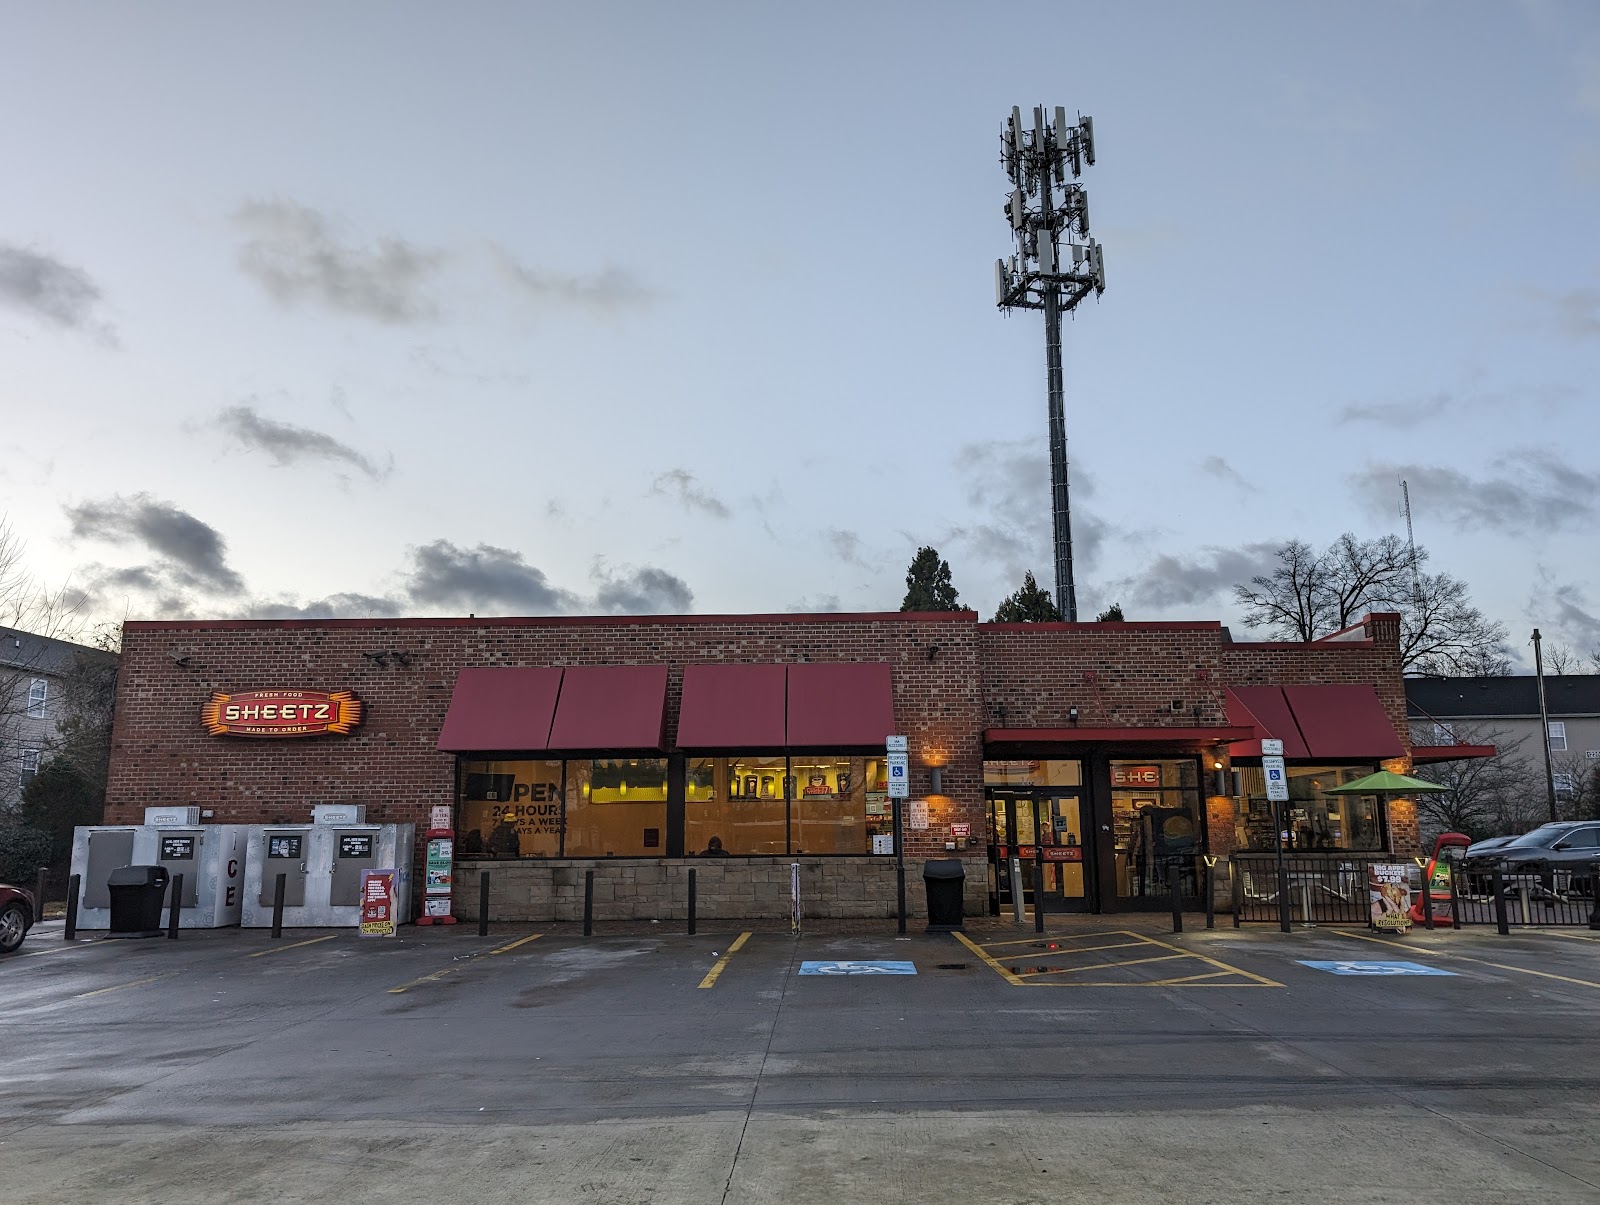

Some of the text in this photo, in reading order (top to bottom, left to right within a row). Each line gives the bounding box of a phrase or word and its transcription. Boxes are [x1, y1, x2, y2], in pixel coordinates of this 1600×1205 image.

[225, 704, 330, 720] SHEETZ
[1115, 772, 1156, 782] SHE
[514, 783, 562, 802] PEN
[492, 805, 510, 816] 24
[226, 831, 238, 906] ICE
[1378, 876, 1402, 884] $7.99
